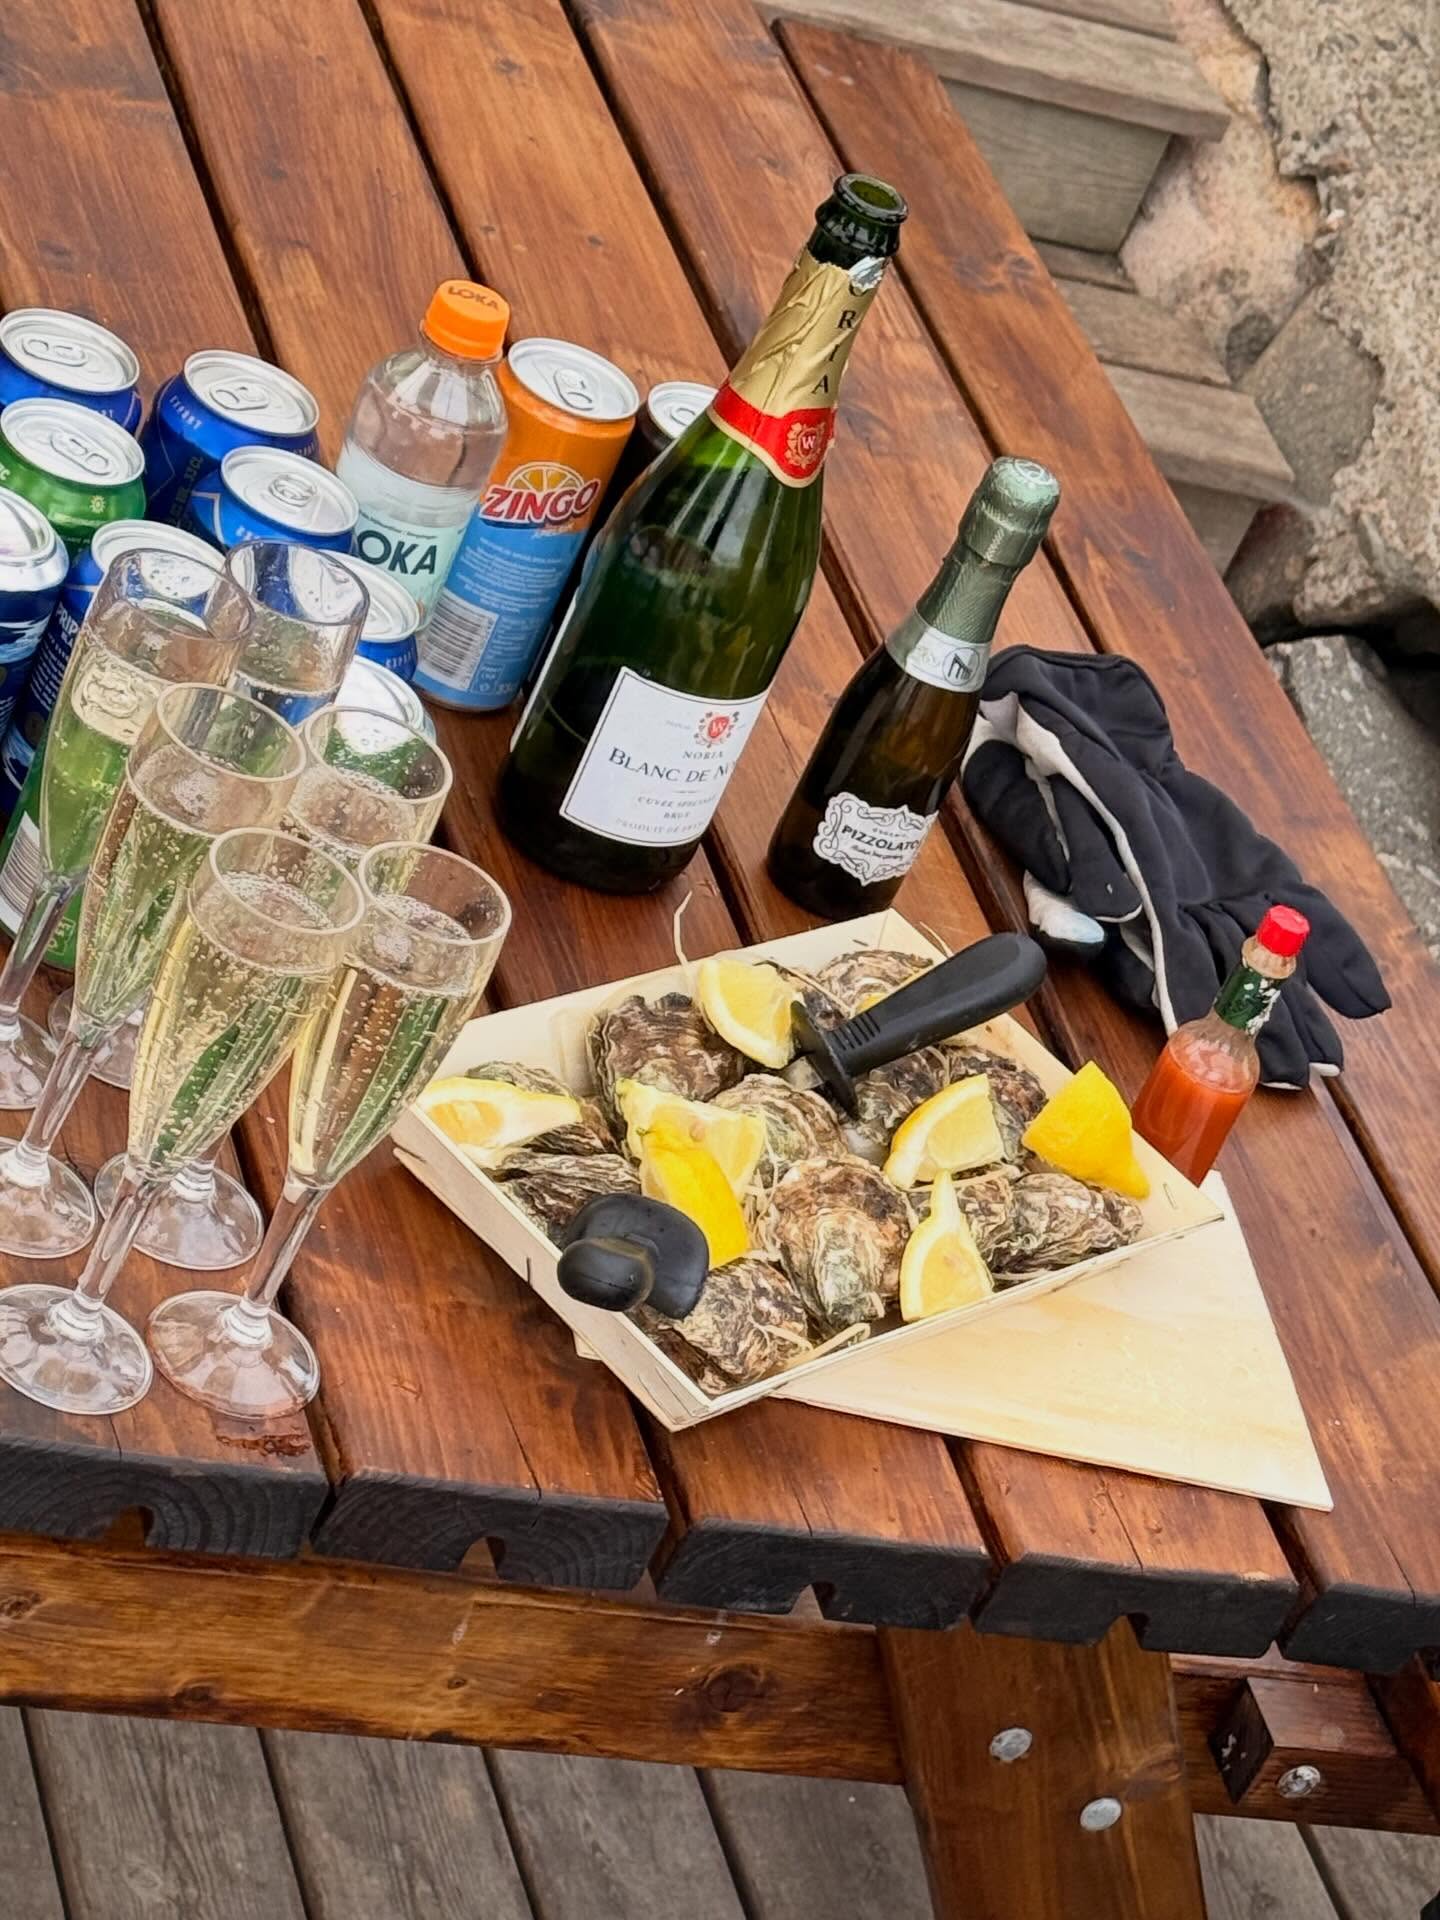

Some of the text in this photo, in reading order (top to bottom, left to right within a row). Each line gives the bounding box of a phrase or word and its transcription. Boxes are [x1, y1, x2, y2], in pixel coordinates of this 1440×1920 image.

[447, 286, 500, 311] LOKA
[481, 480, 599, 523] ZINGO
[357, 529, 439, 575] OKA
[609, 747, 681, 782] BLANC
[685, 769, 712, 783] DE
